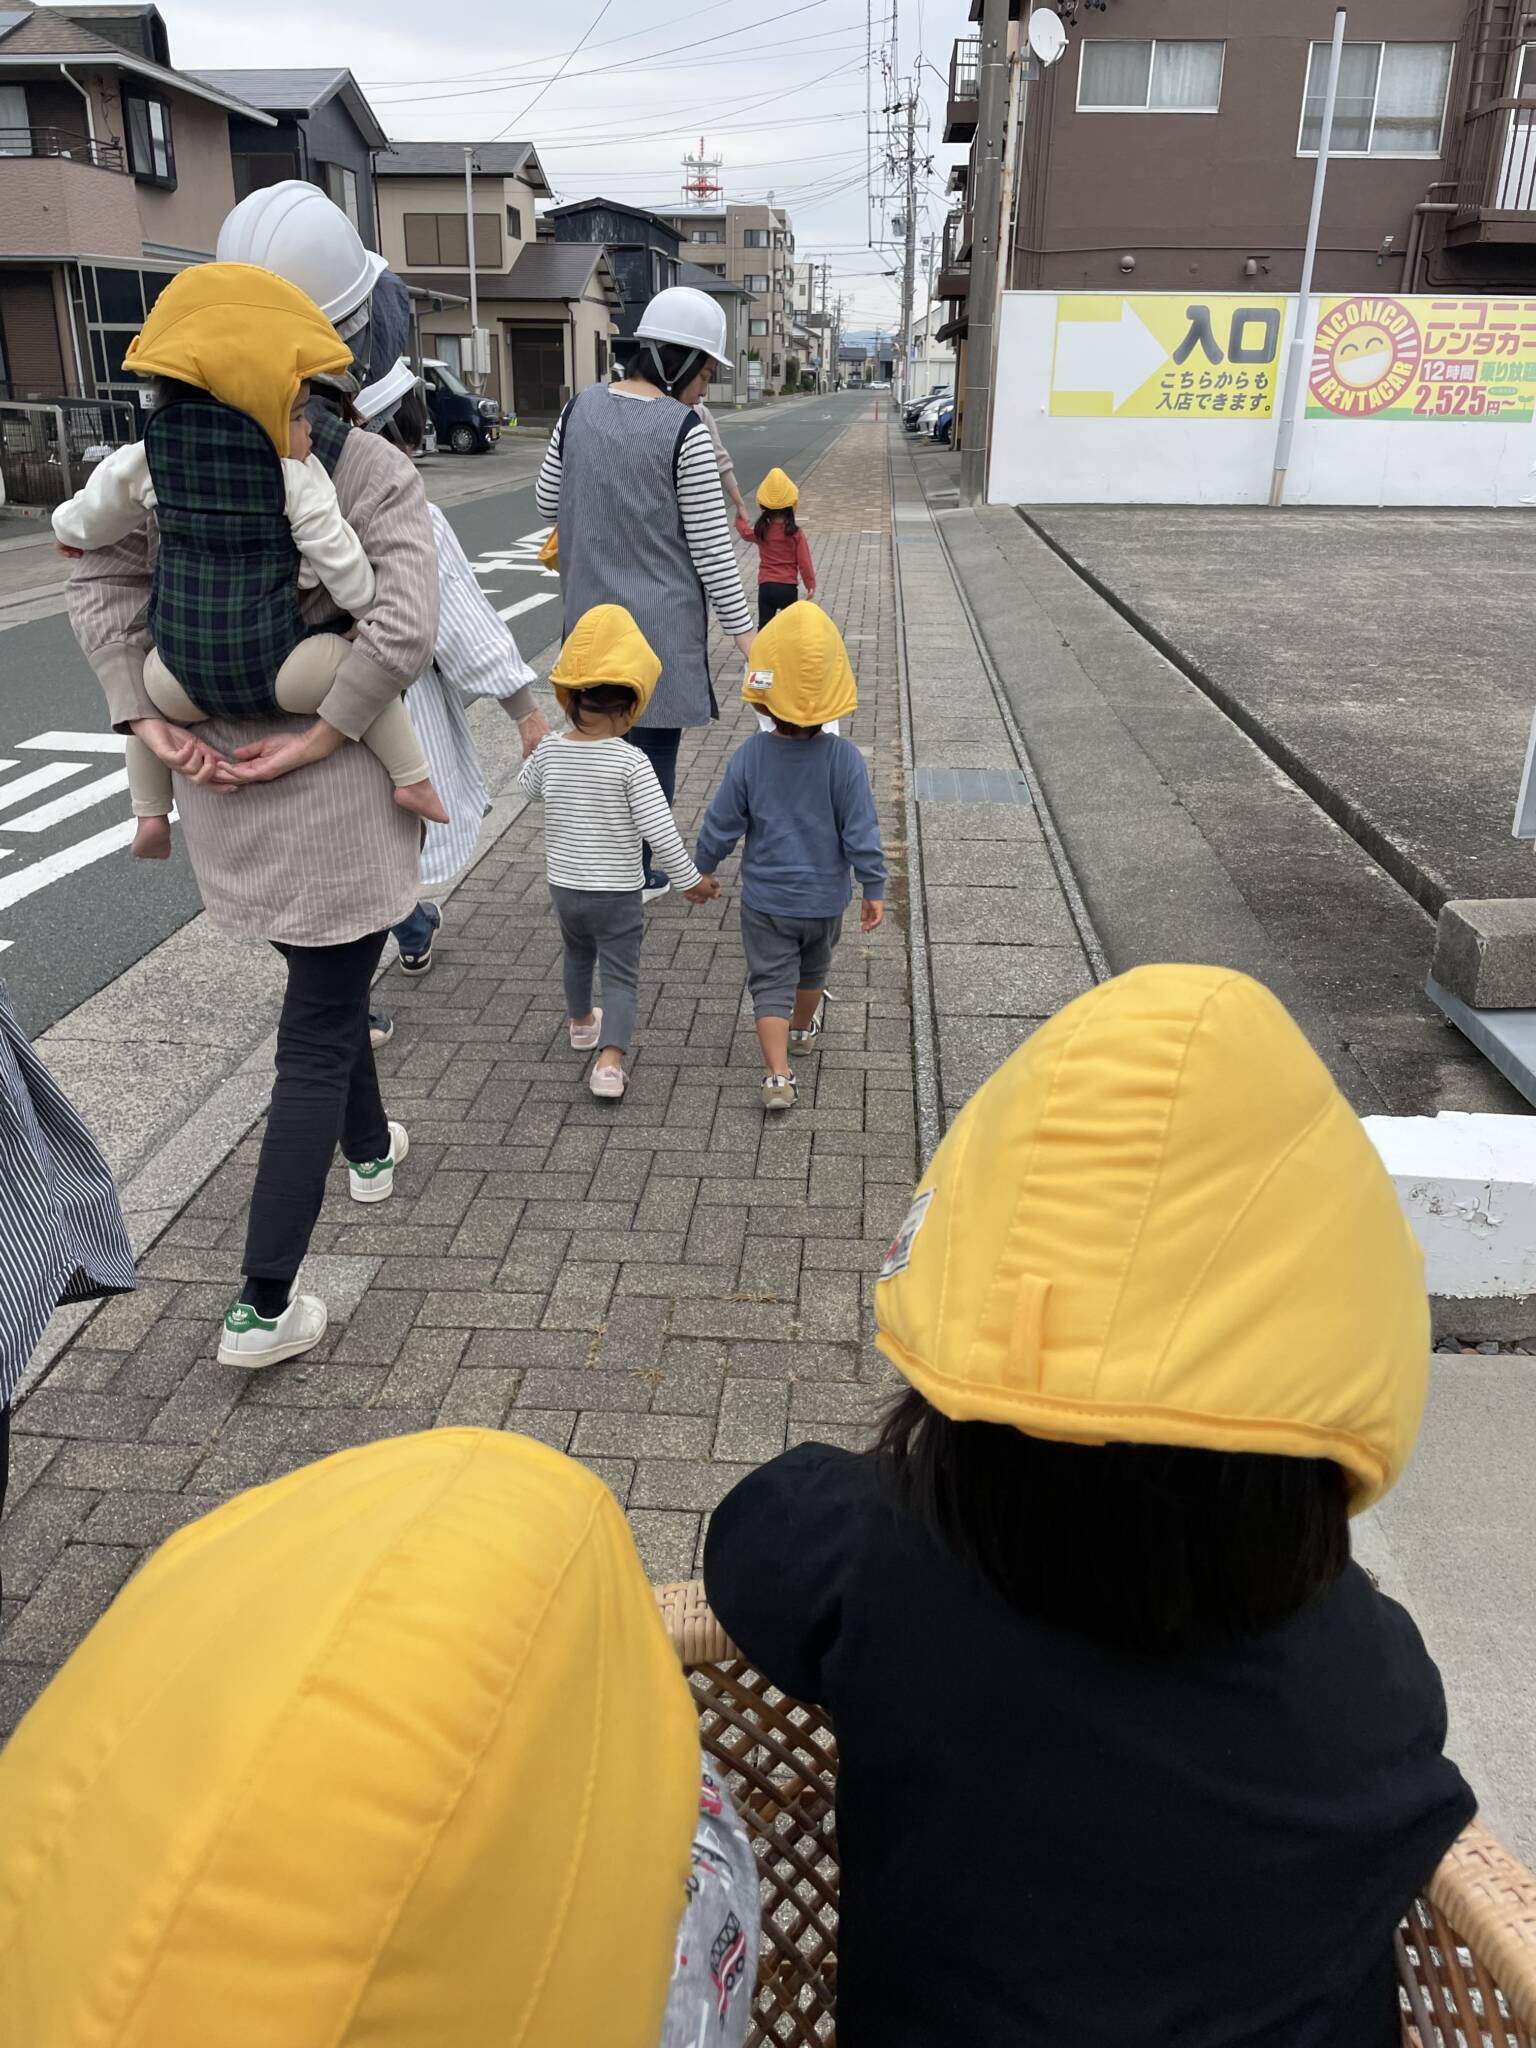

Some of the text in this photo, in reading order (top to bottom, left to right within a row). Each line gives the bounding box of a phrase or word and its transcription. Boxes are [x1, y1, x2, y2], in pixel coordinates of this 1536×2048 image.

[1172, 304, 1281, 366] 入口
[1315, 300, 1409, 352] NICONICO
[1423, 331, 1536, 356] レンタカー
[1160, 371, 1268, 390] こちらからも
[1423, 360, 1475, 381] 12時間
[1317, 360, 1414, 412] RENTACAR
[1155, 392, 1271, 412] 入店できます。
